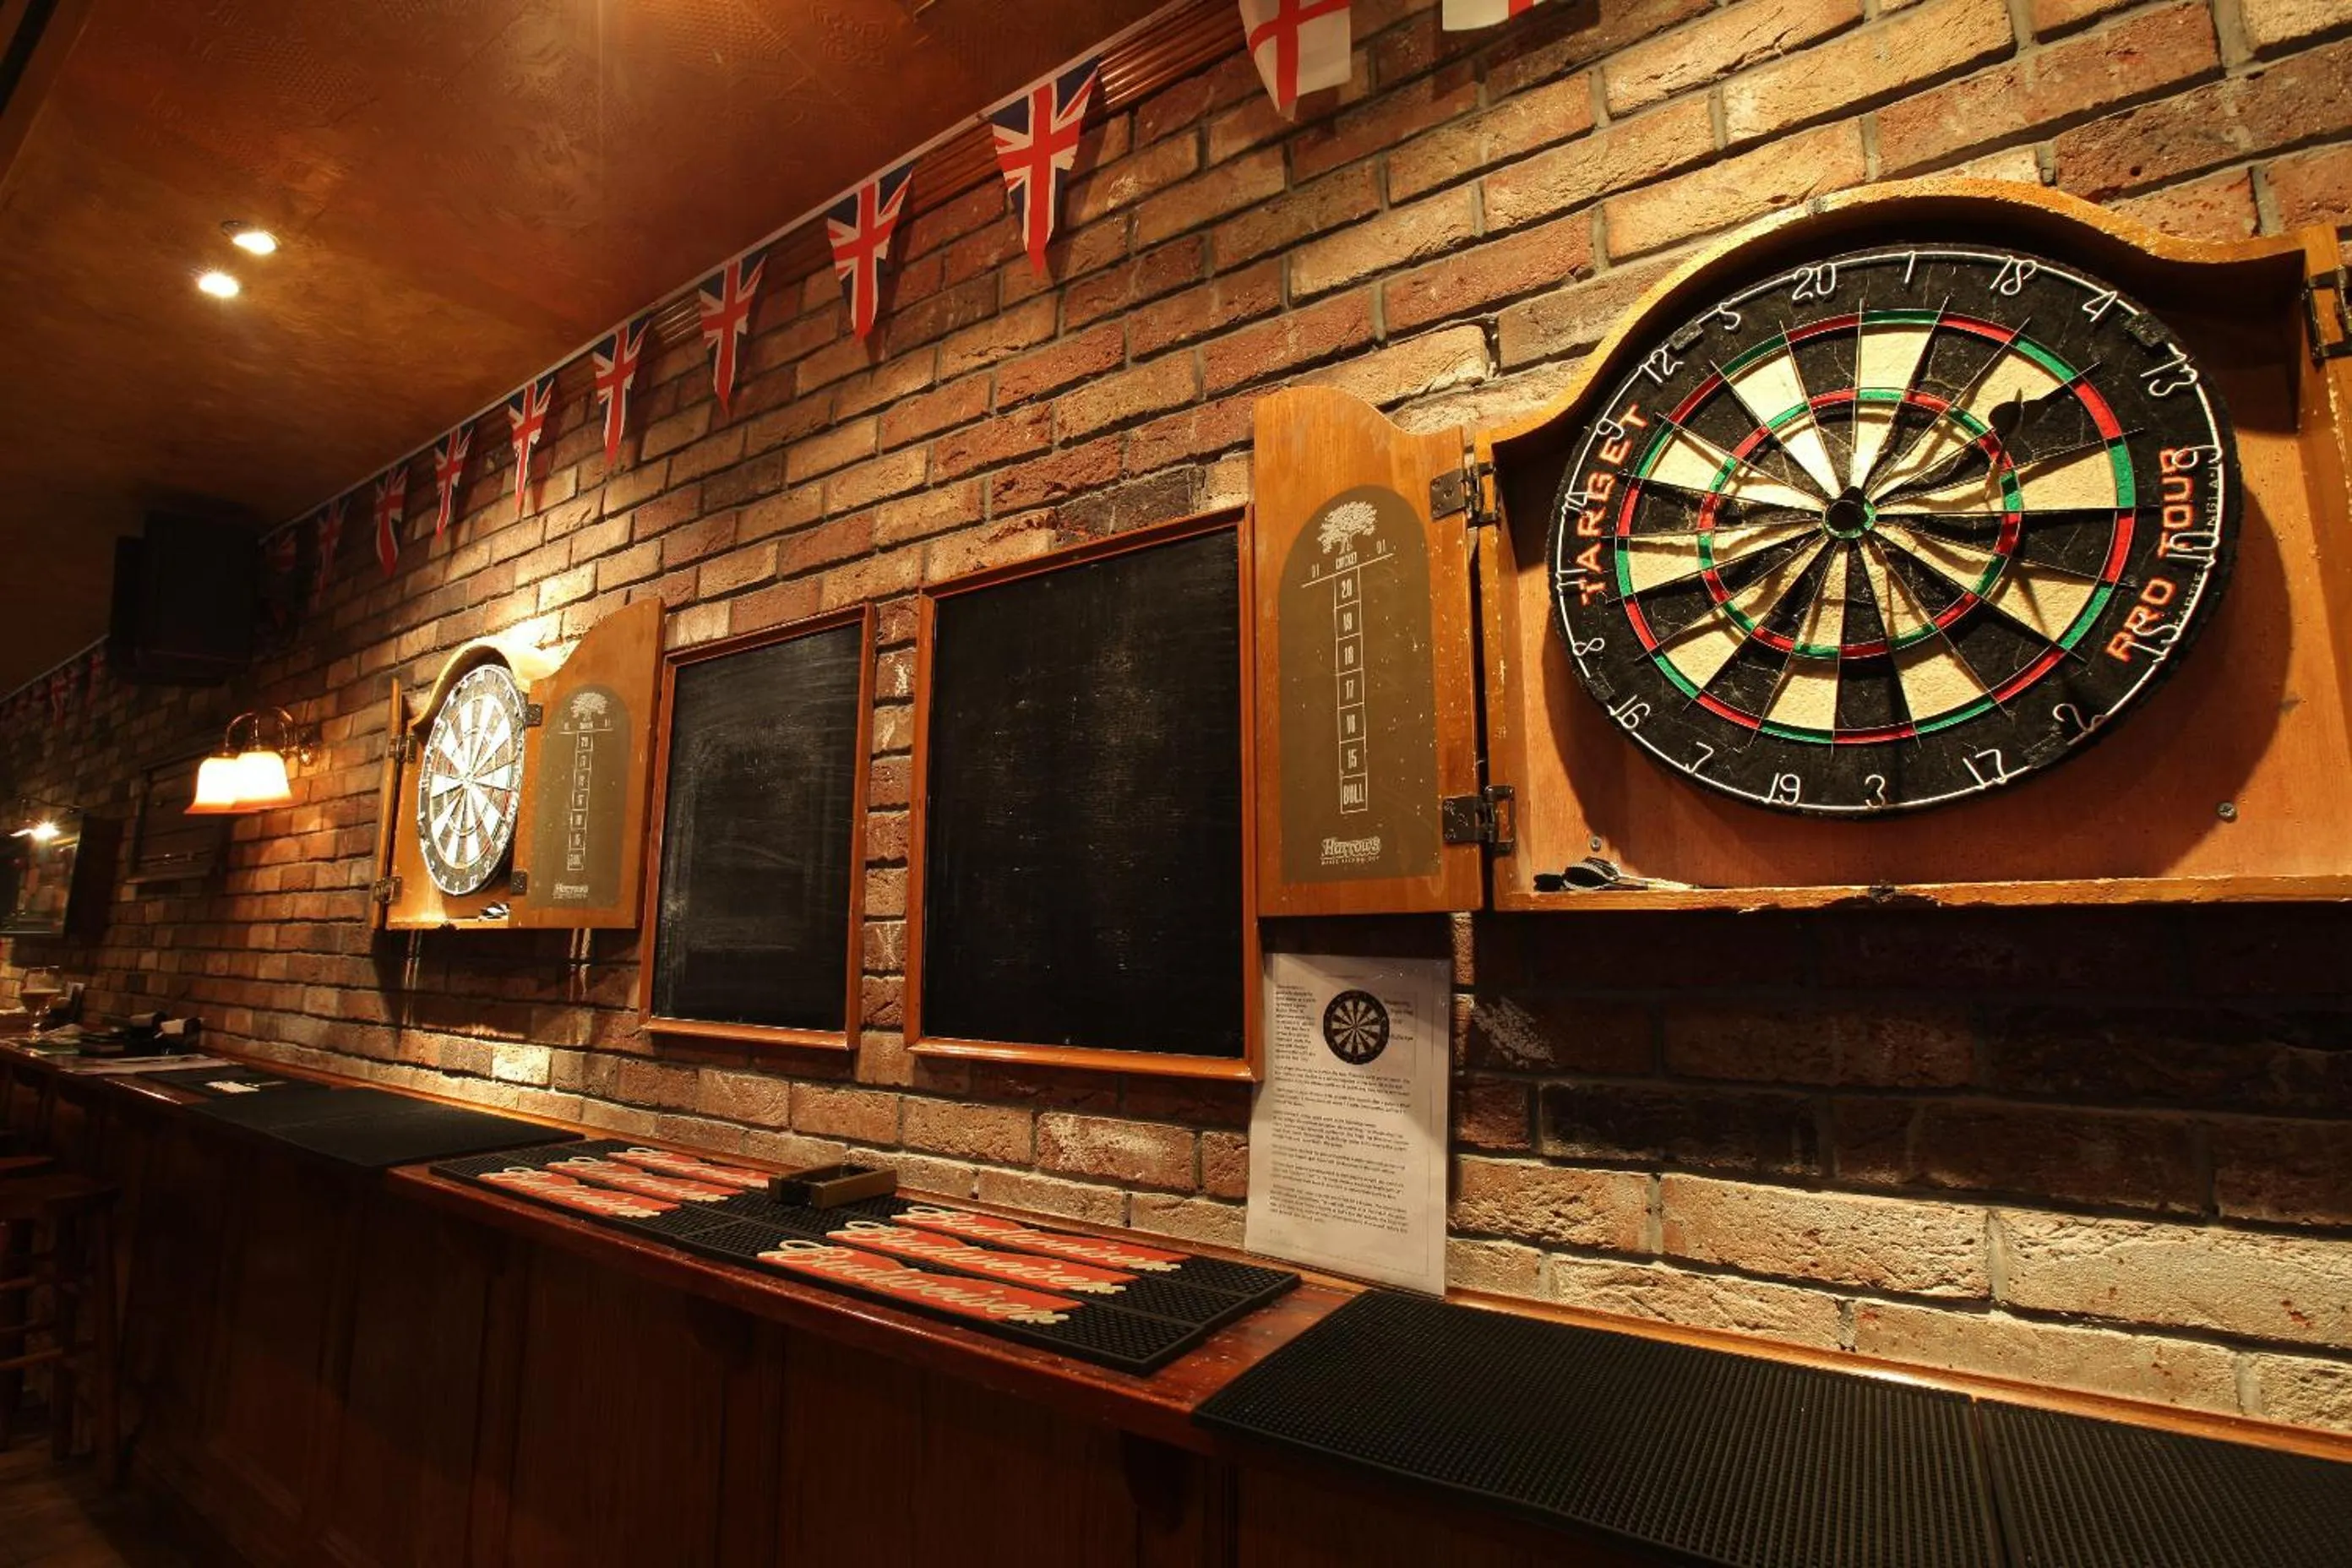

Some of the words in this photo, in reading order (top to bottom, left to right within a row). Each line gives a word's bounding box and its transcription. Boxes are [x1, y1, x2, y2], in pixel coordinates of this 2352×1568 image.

[1792, 262, 1838, 301] 20
[1904, 251, 1916, 284] 1
[1990, 255, 2038, 297] 18
[1718, 302, 1742, 330] 5
[2082, 290, 2118, 322] 4
[1639, 344, 1685, 384] 12
[2140, 353, 2199, 397] 13
[1576, 403, 1648, 606] TARGET
[2105, 575, 2178, 663] PRO
[2157, 445, 2195, 559] TOUR
[1341, 578, 1353, 599] 20
[1573, 637, 1605, 658] 8
[1608, 694, 1651, 729] 16
[1348, 749, 1358, 770] 15
[1685, 741, 1714, 773] 7
[1963, 749, 2008, 790] 17
[1343, 783, 1365, 805] BULL
[1764, 772, 1801, 804] 19
[1865, 774, 1887, 807] 3
[825, 1221, 1127, 1293] Budweiser
[757, 1239, 1070, 1325] Budweiser
